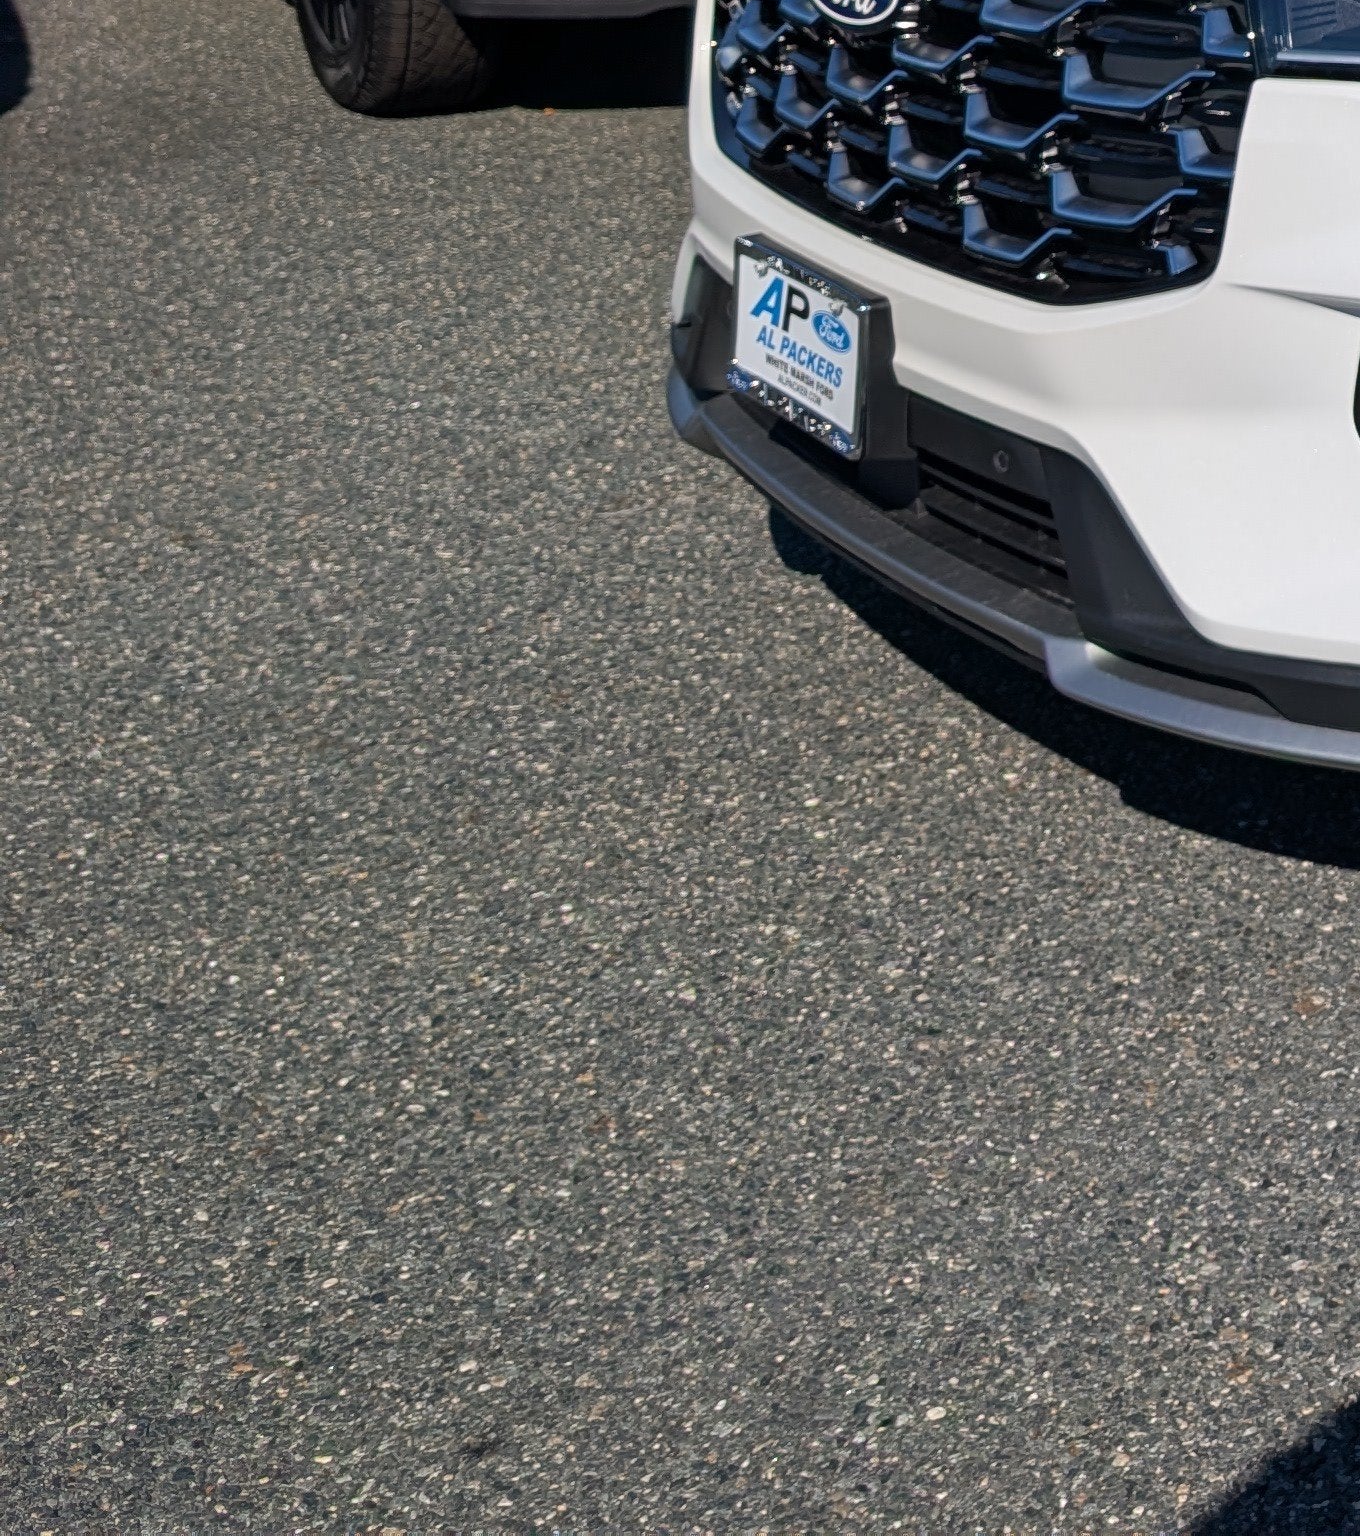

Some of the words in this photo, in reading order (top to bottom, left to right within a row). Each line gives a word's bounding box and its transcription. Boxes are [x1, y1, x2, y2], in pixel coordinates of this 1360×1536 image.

[750, 277, 810, 333] AP
[817, 312, 847, 350] Ford
[756, 325, 775, 350] AL
[779, 334, 843, 388] PACKERS
